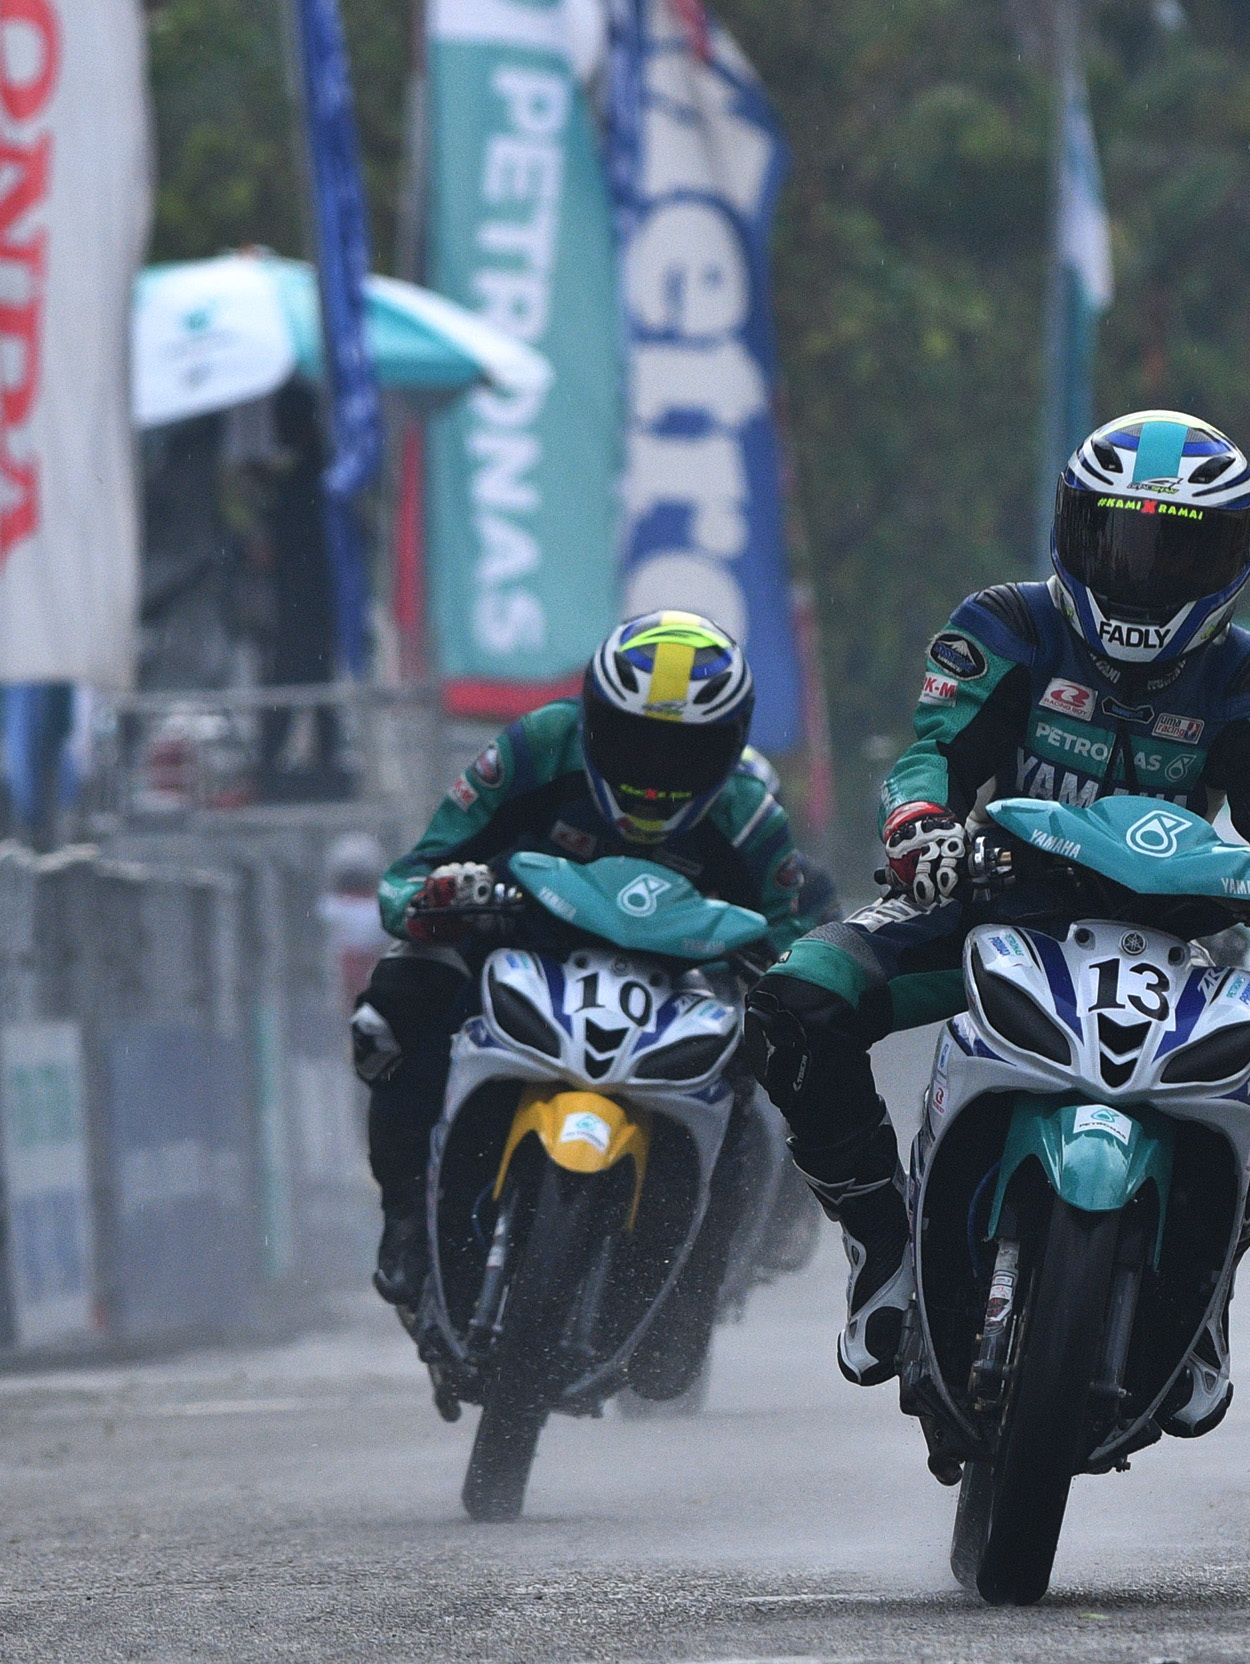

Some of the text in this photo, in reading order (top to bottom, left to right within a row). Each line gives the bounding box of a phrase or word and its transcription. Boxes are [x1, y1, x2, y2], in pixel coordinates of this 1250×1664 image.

[1100, 621, 1171, 648] FADLY
[1044, 698, 1071, 712] RACING
[1157, 723, 1185, 737] racing
[1160, 716, 1182, 727] uma
[1029, 829, 1081, 859] YAMAHA
[574, 972, 652, 1027] 10
[1088, 958, 1170, 1021] 13
